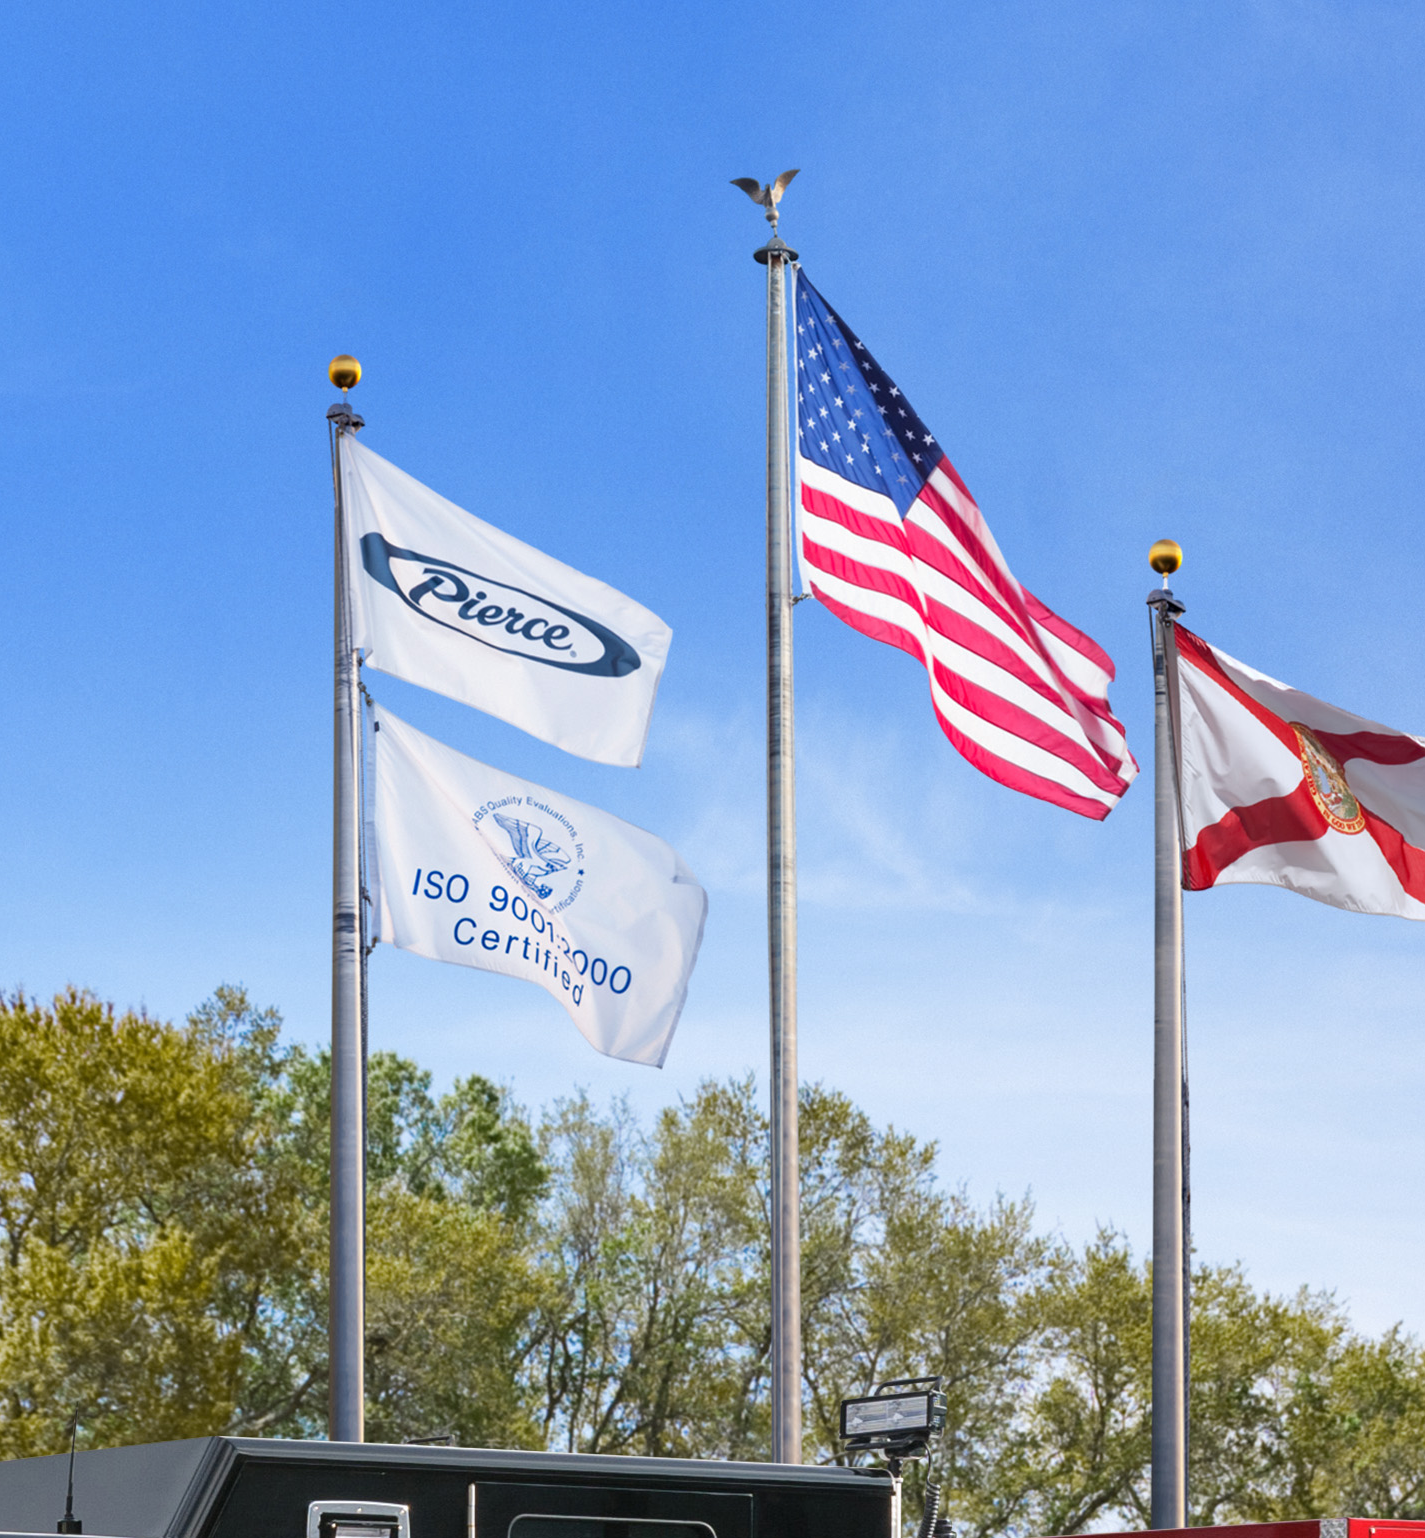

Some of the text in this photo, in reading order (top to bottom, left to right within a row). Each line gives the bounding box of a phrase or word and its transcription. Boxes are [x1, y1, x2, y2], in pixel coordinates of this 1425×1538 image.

[408, 567, 574, 651] Pierce
[487, 796, 522, 811] Quality
[526, 796, 578, 841] Evaluations,
[575, 843, 585, 862] Inc.
[412, 868, 632, 994] ISO 9001:2000
[454, 918, 584, 1007] Certified
